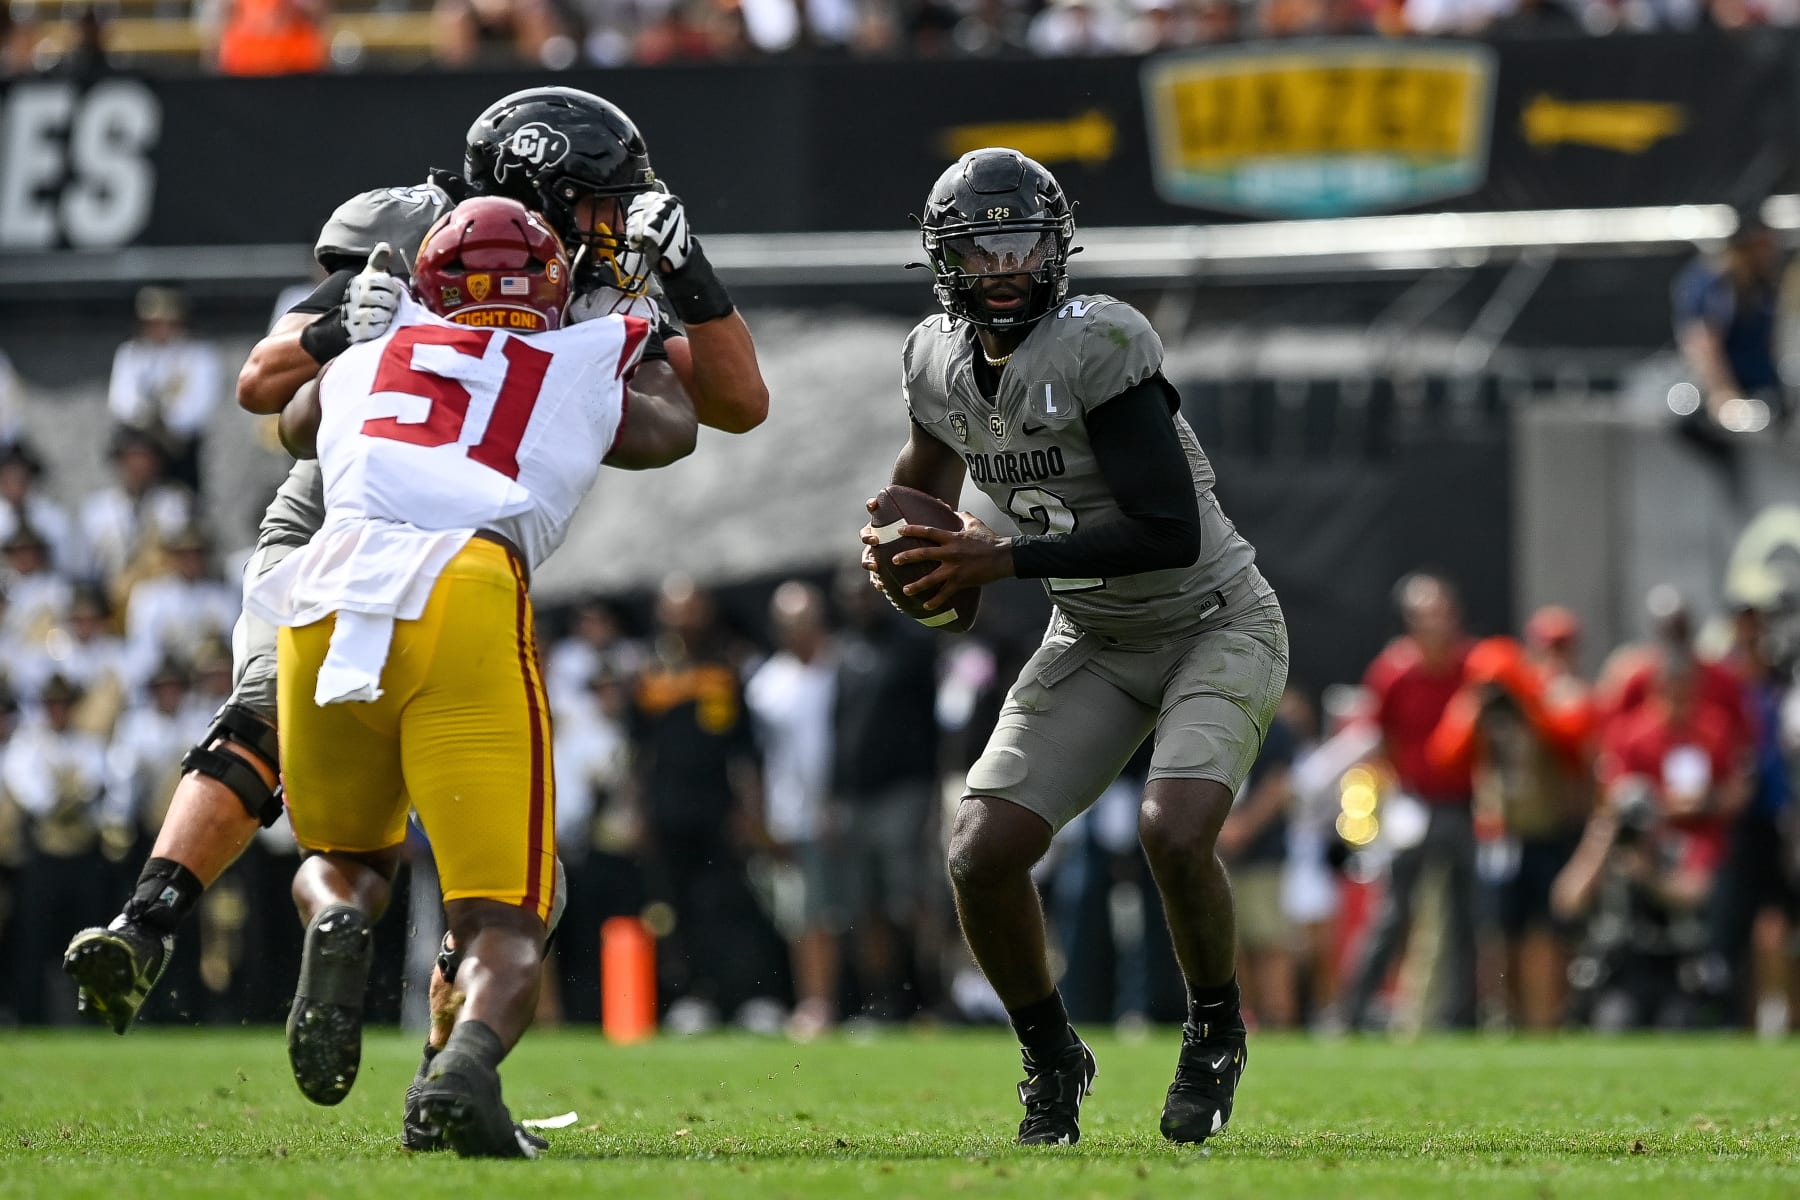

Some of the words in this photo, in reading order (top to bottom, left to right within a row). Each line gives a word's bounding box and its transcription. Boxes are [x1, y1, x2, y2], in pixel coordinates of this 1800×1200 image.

[987, 207, 1009, 219] S2S
[509, 311, 537, 328] ON!
[360, 325, 553, 482] 51
[1045, 383, 1057, 413] L
[964, 445, 1065, 484] COLORADO
